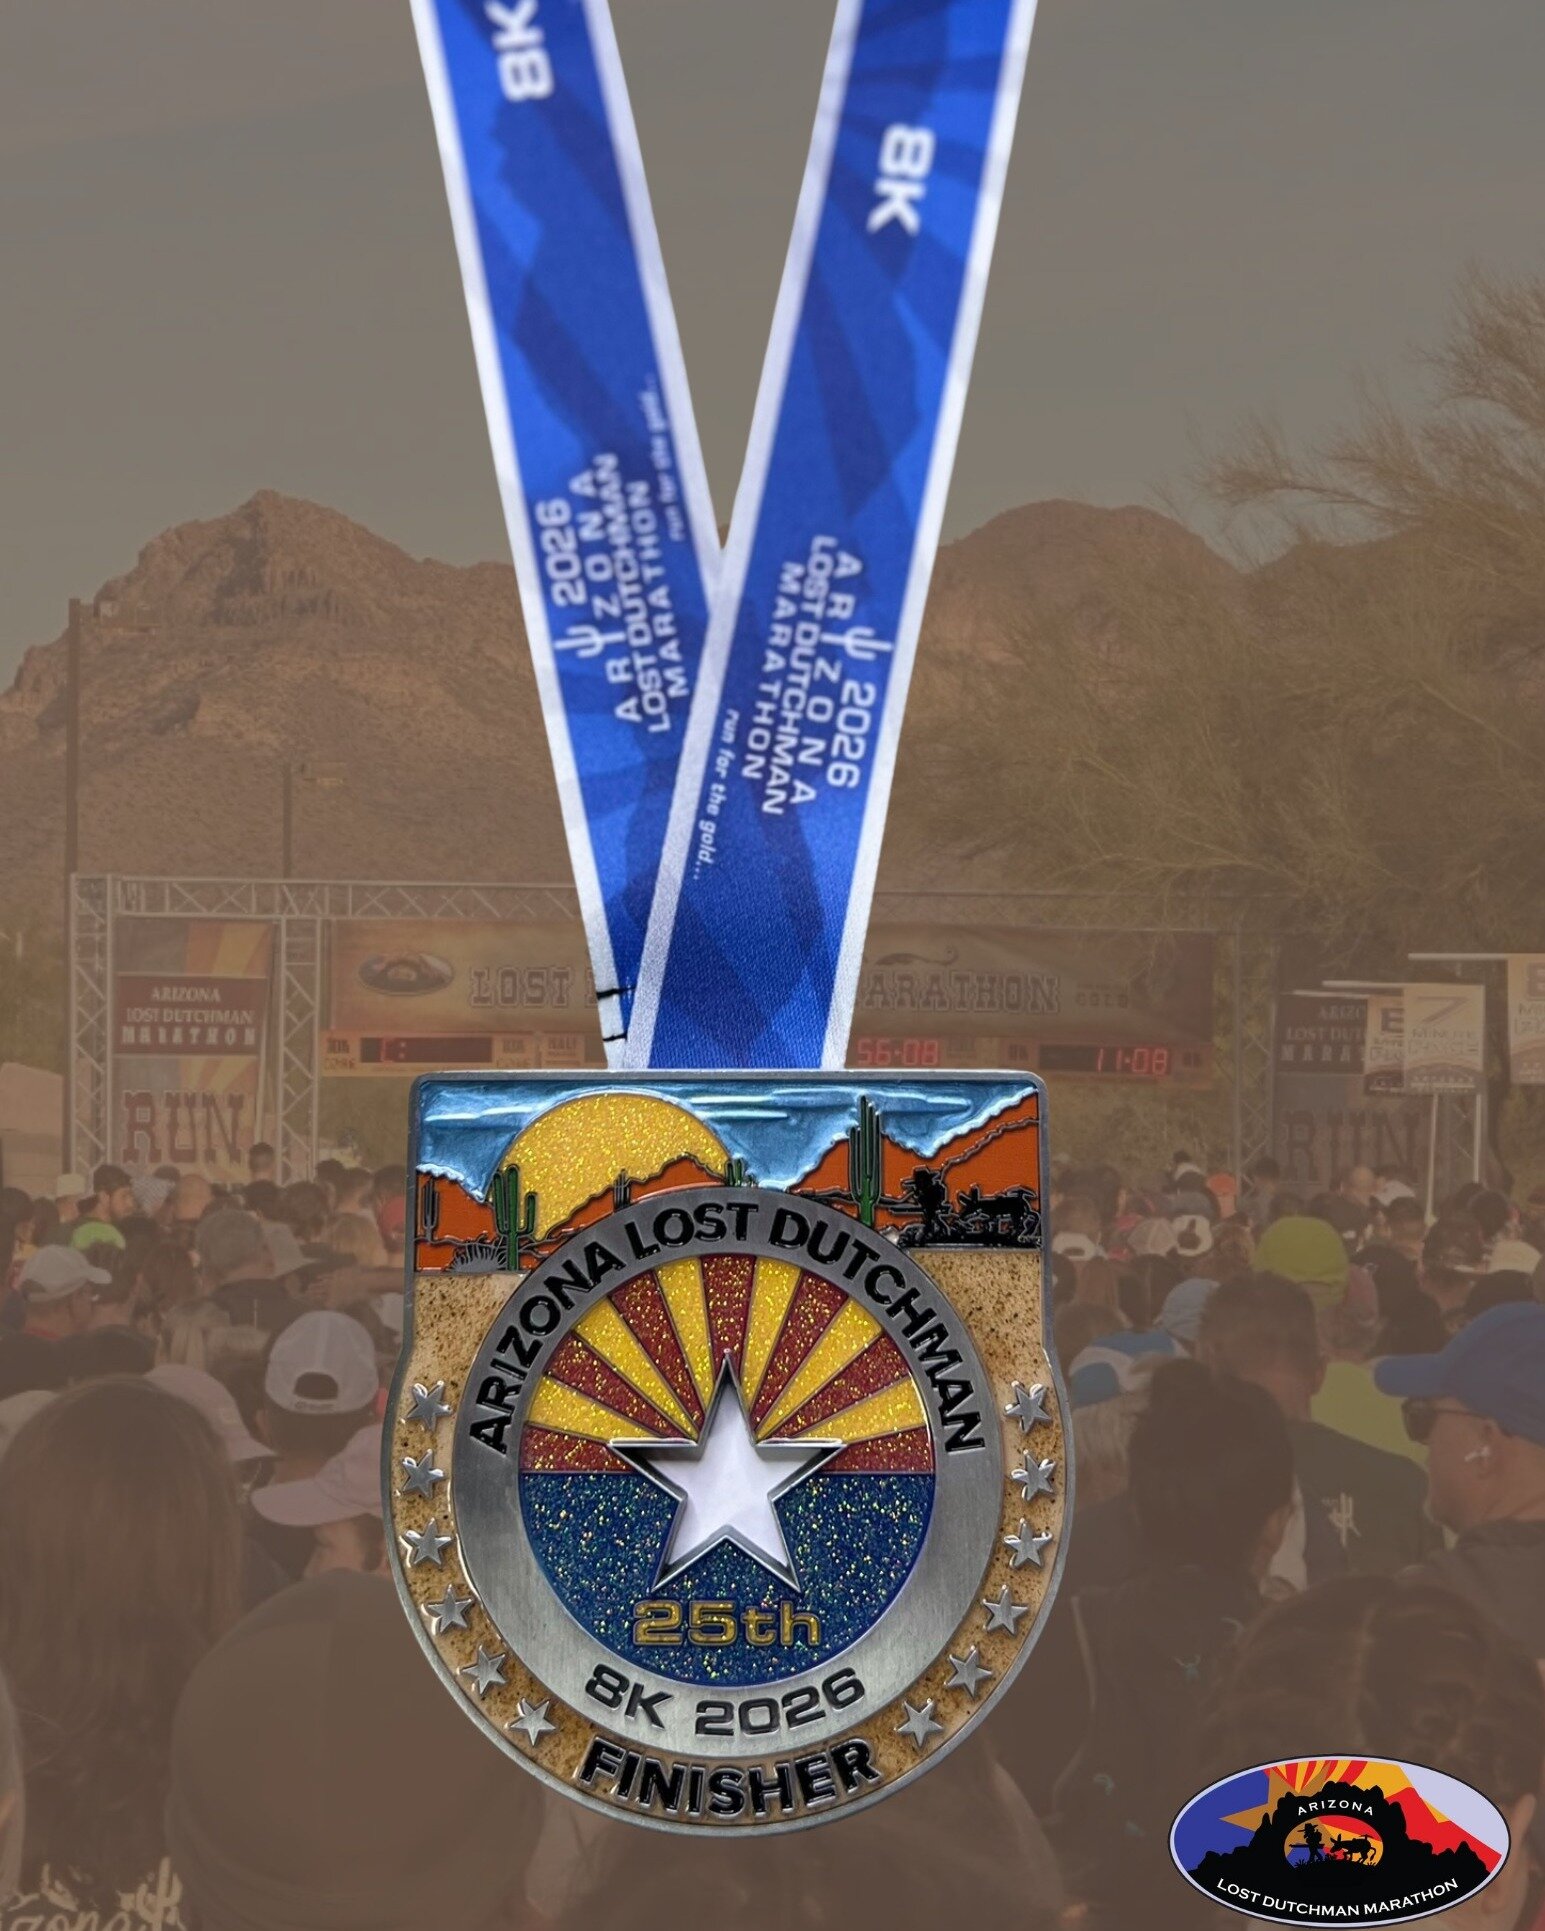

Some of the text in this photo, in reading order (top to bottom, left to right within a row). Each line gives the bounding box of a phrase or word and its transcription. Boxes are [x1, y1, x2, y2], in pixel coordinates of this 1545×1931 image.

[484, 0, 555, 102] 8K
[866, 123, 936, 236] 8K
[534, 497, 588, 608] 2026
[625, 480, 690, 698] MARATHON
[593, 452, 671, 733] LOST DUTCHMAN
[741, 561, 805, 780] MARATHON
[762, 535, 838, 815] LOST DUTCHMAN
[711, 747, 736, 778] for
[721, 708, 740, 744] run
[826, 681, 876, 790] 2026
[706, 784, 728, 816] the
[126, 1007, 255, 1025] LOST DUTCHMAN
[152, 986, 221, 1002] ARIZONA
[471, 967, 572, 1008] LOST
[857, 970, 1060, 1013] ARATHON
[121, 1025, 257, 1046] MARATHON
[1286, 1026, 1327, 1041] LOST
[122, 1090, 245, 1164] RUN
[468, 1202, 986, 1455] ARIZONA LOST DUTCHMAN
[633, 1600, 821, 1647] 25th
[584, 1663, 866, 1737] 8K 2026
[577, 1736, 882, 1817] FINISHER
